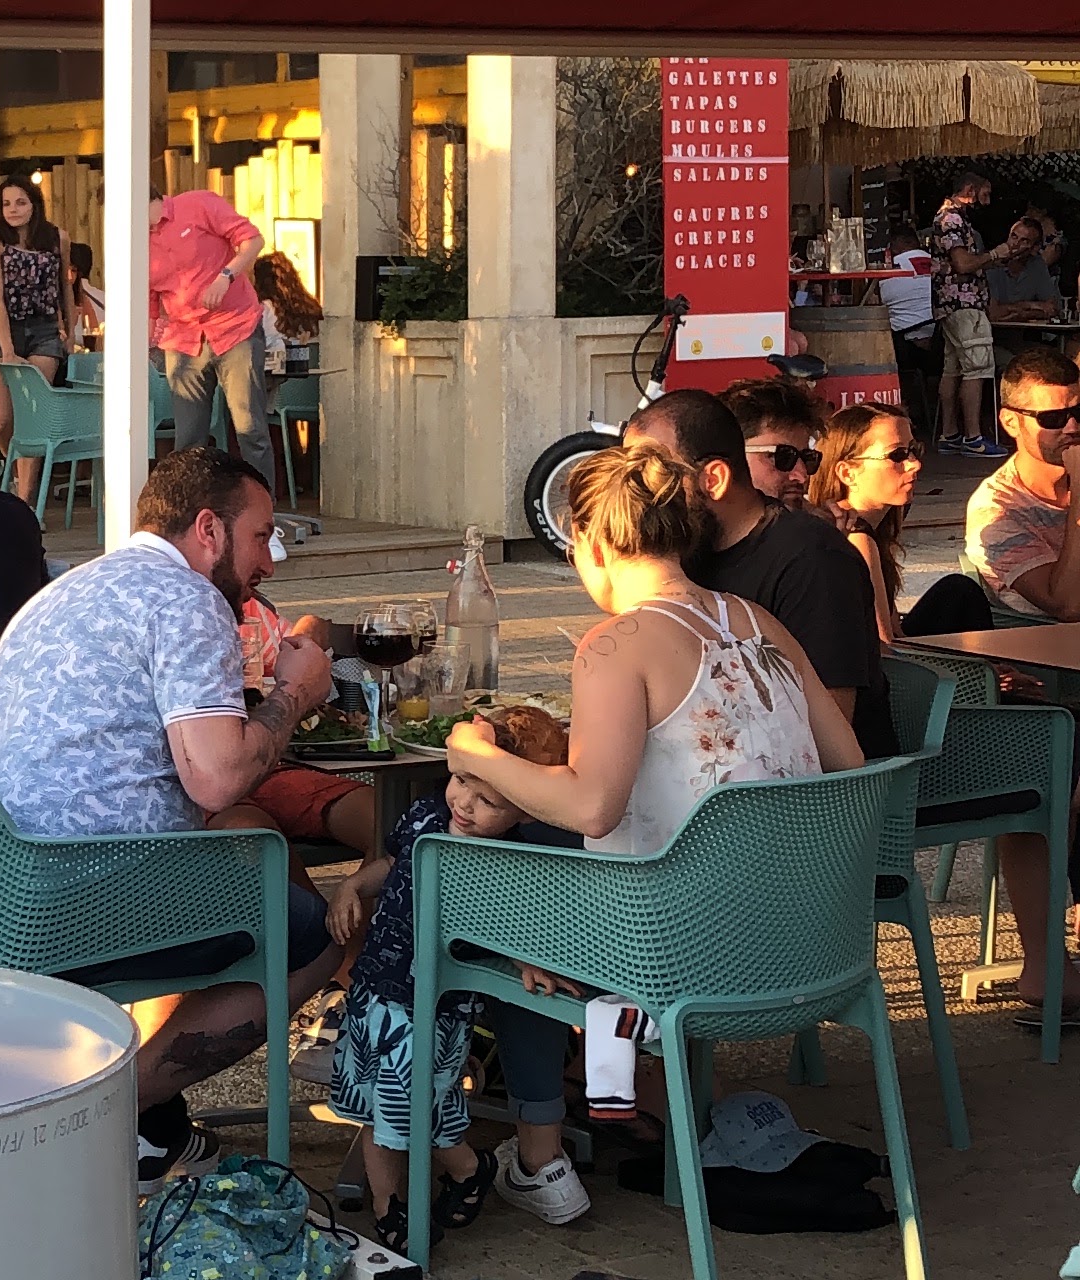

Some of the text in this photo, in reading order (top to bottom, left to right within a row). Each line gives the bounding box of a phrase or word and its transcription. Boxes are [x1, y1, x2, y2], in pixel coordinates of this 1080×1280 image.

[668, 71, 777, 86] GALETTES
[670, 95, 738, 110] TAPAS
[671, 119, 767, 134] BURGERS
[671, 143, 753, 158] MOULES
[673, 166, 768, 182] SALADES
[673, 205, 768, 222] GAUFRES
[674, 229, 754, 246] CREPES
[675, 253, 756, 270] GLACES
[533, 498, 568, 551] ENDA
[545, 1165, 567, 1184] NIKE
